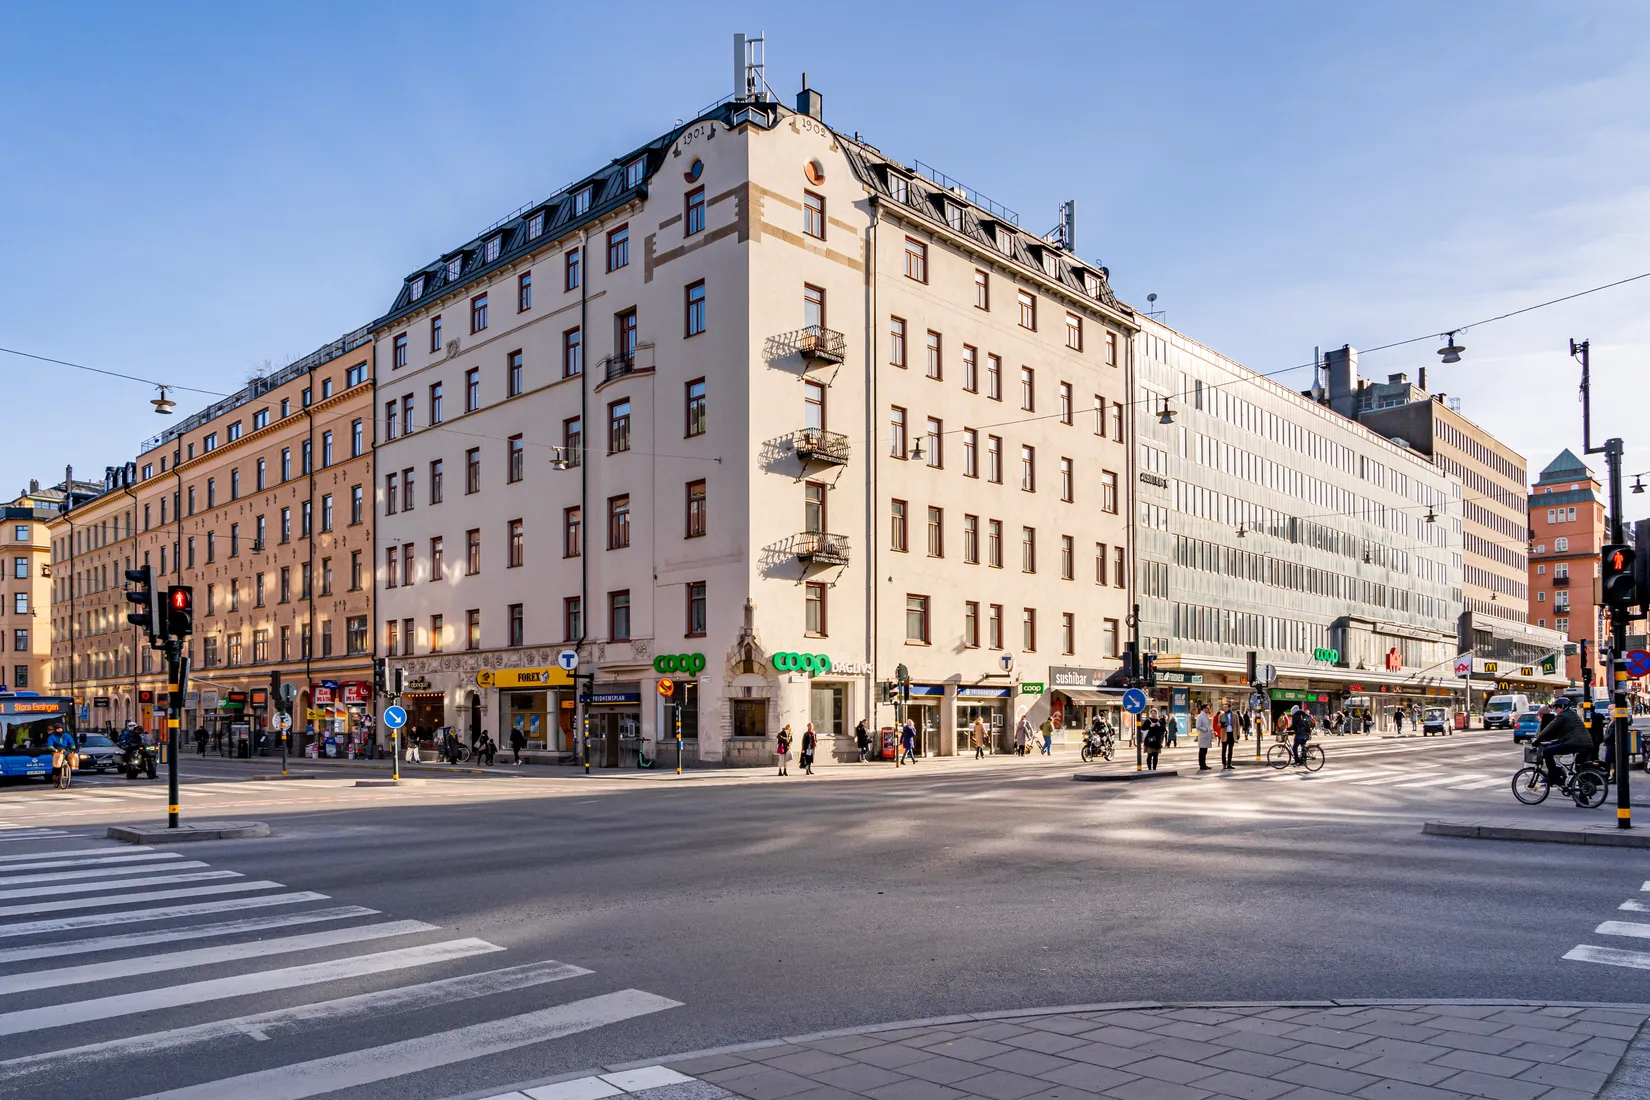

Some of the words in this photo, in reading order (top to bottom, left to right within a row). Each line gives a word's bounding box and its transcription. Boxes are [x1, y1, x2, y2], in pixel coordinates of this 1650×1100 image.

[683, 125, 705, 146] 1901
[802, 117, 827, 139] 1902
[562, 653, 575, 668] T
[772, 651, 831, 677] coop
[831, 662, 874, 675] DAGLIVS
[1001, 656, 1011, 669] T
[1314, 647, 1339, 665] coop
[653, 652, 706, 677] coop
[518, 672, 540, 683] FOREX
[1055, 671, 1087, 685] sushibar
[14, 703, 32, 711] Stora
[32, 702, 60, 713] Essingen
